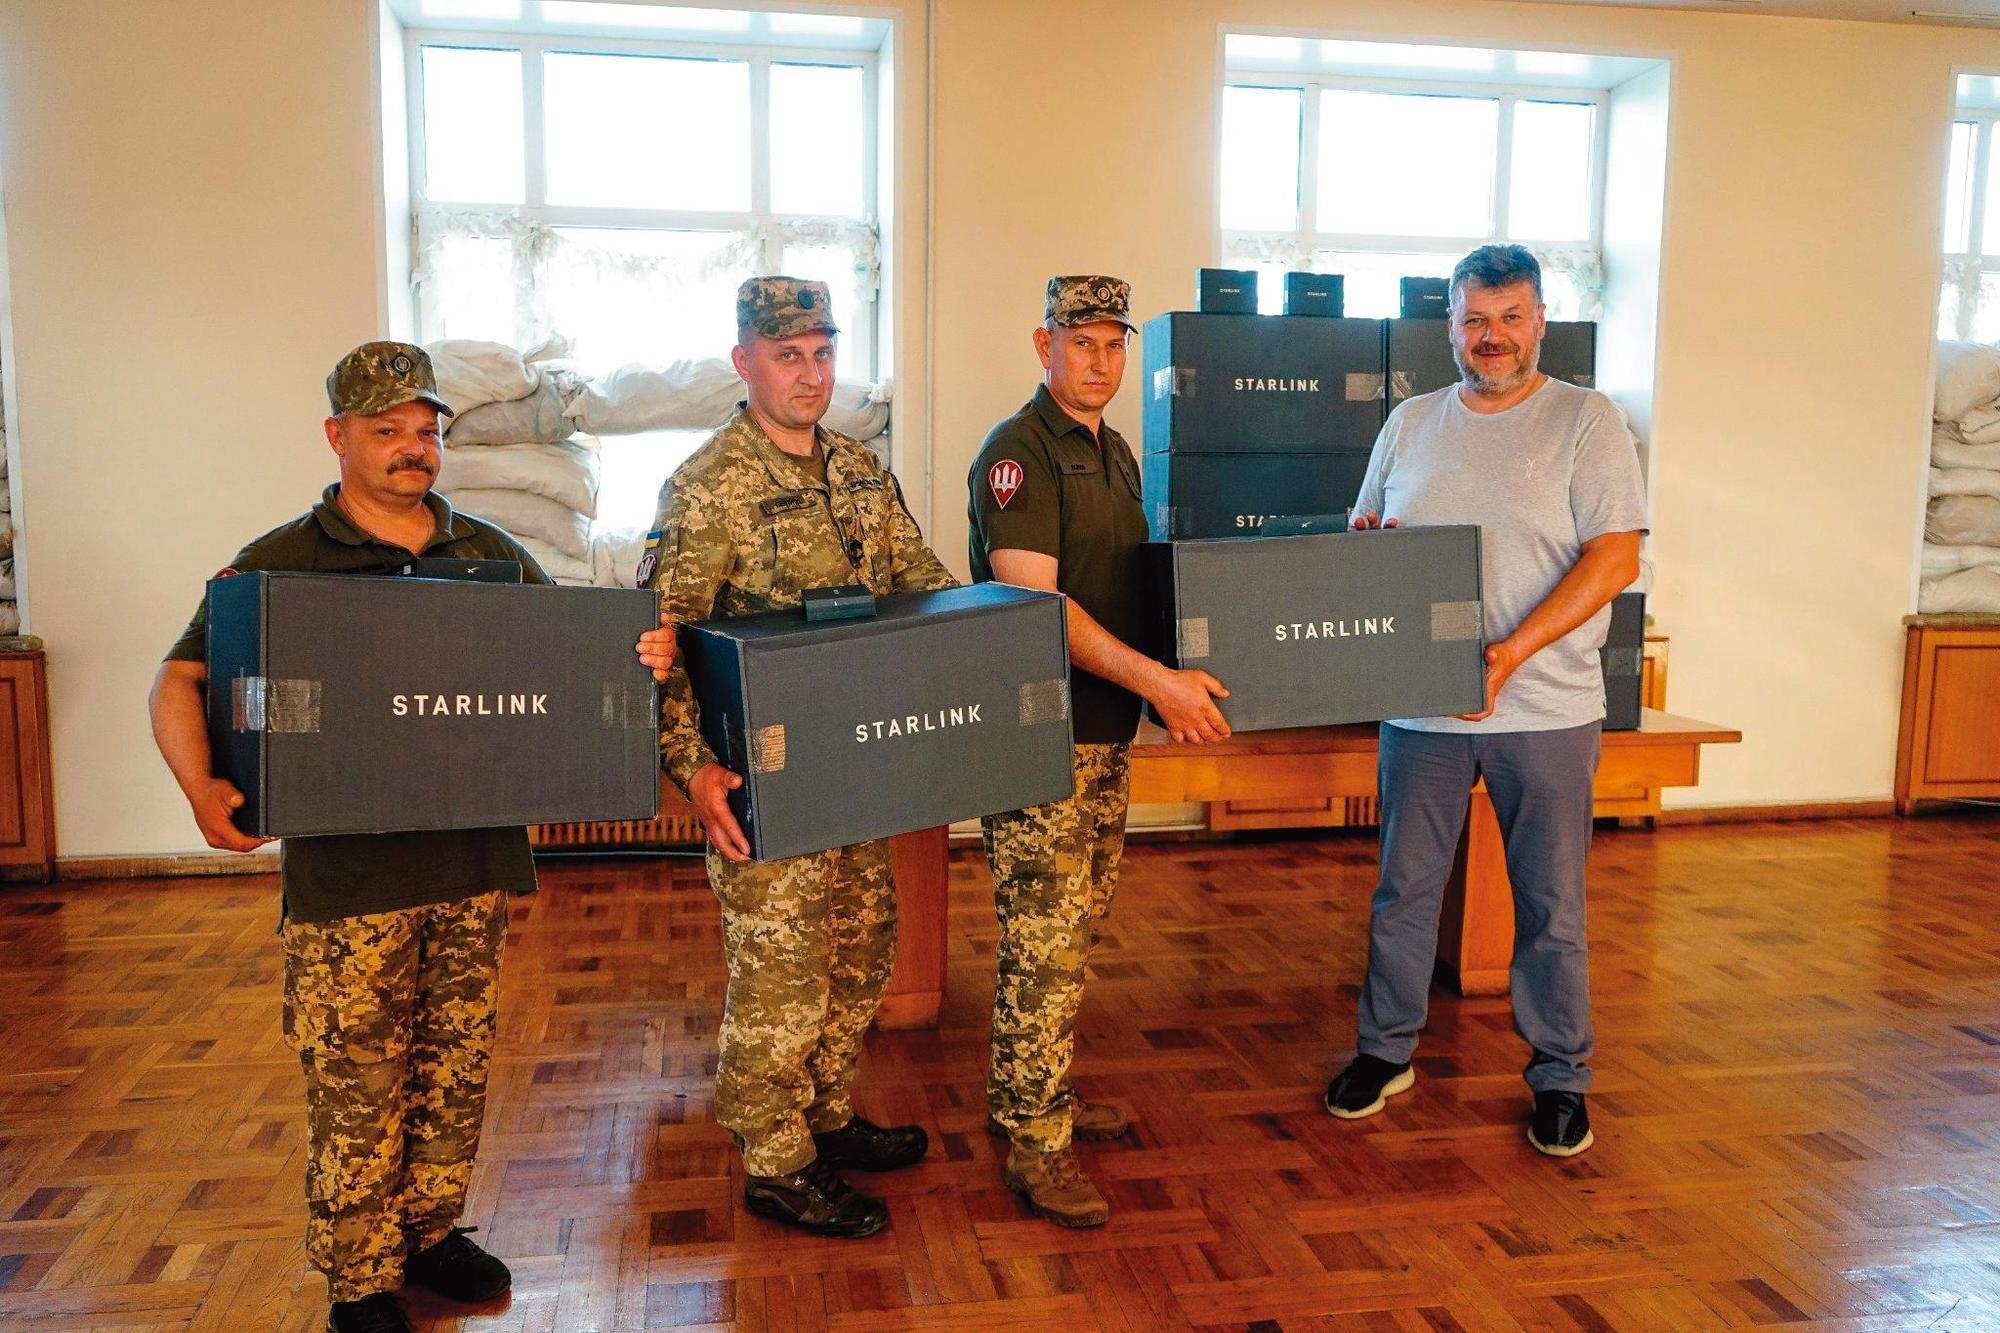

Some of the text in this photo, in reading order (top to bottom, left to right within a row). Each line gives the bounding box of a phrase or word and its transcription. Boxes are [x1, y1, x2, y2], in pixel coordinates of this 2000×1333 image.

[1234, 378, 1320, 392] STARLINK
[1275, 616, 1396, 641] STARLINK
[392, 694, 548, 716] STARLINK
[855, 704, 982, 743] STARLINK
